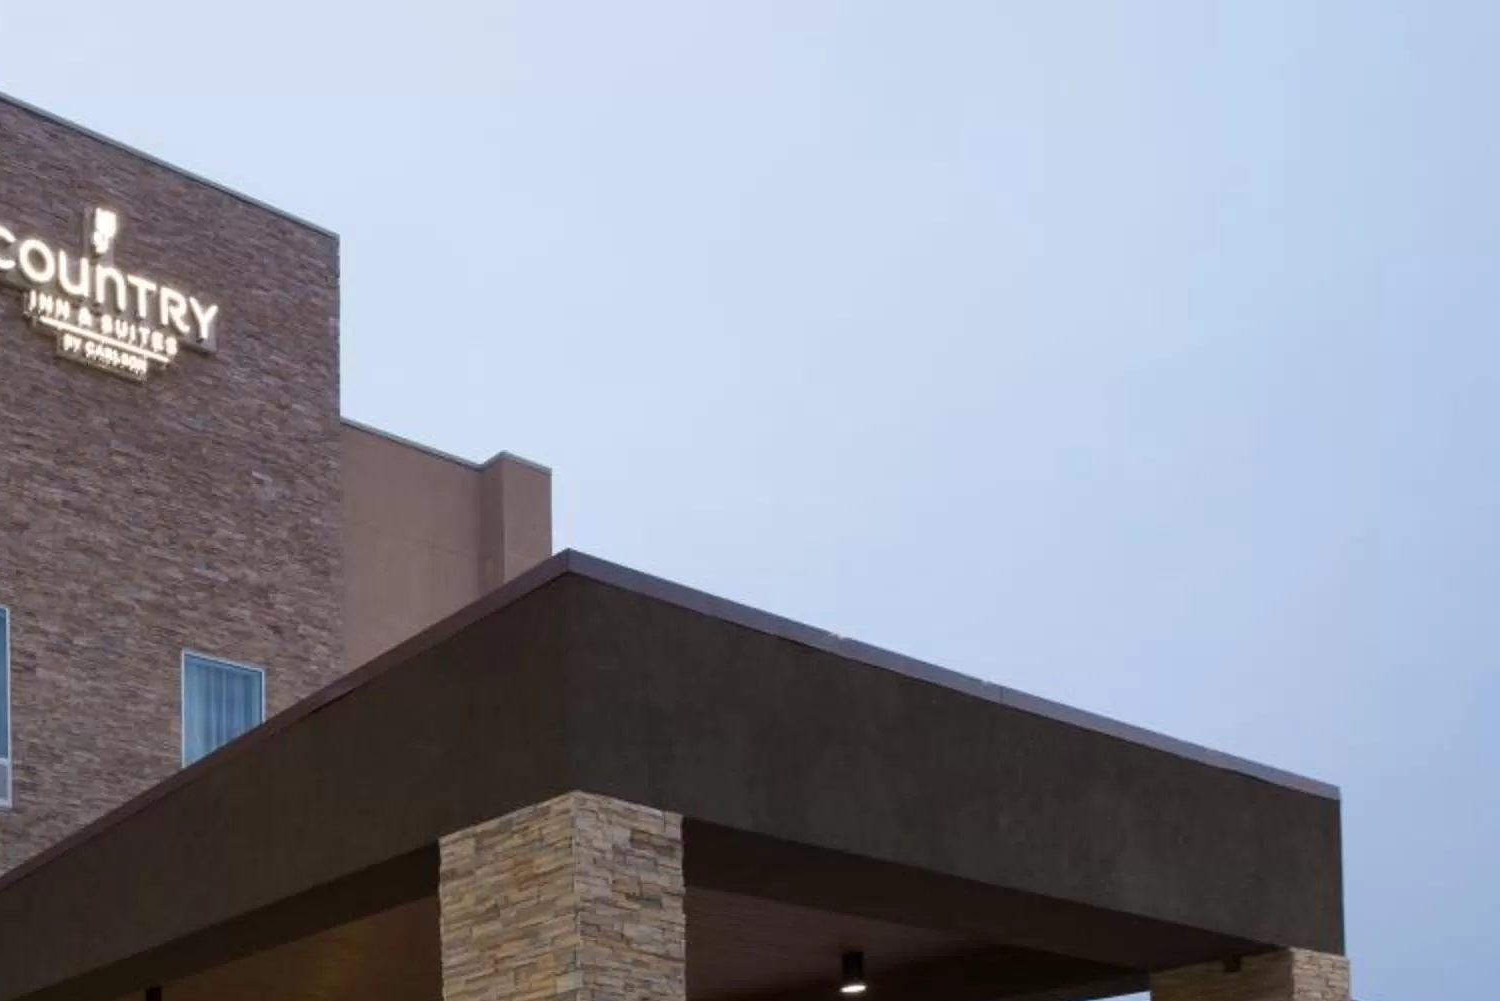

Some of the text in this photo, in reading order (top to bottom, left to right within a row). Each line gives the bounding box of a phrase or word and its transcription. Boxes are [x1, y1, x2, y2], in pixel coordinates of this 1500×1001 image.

[28, 289, 179, 357] INN & SUITES
